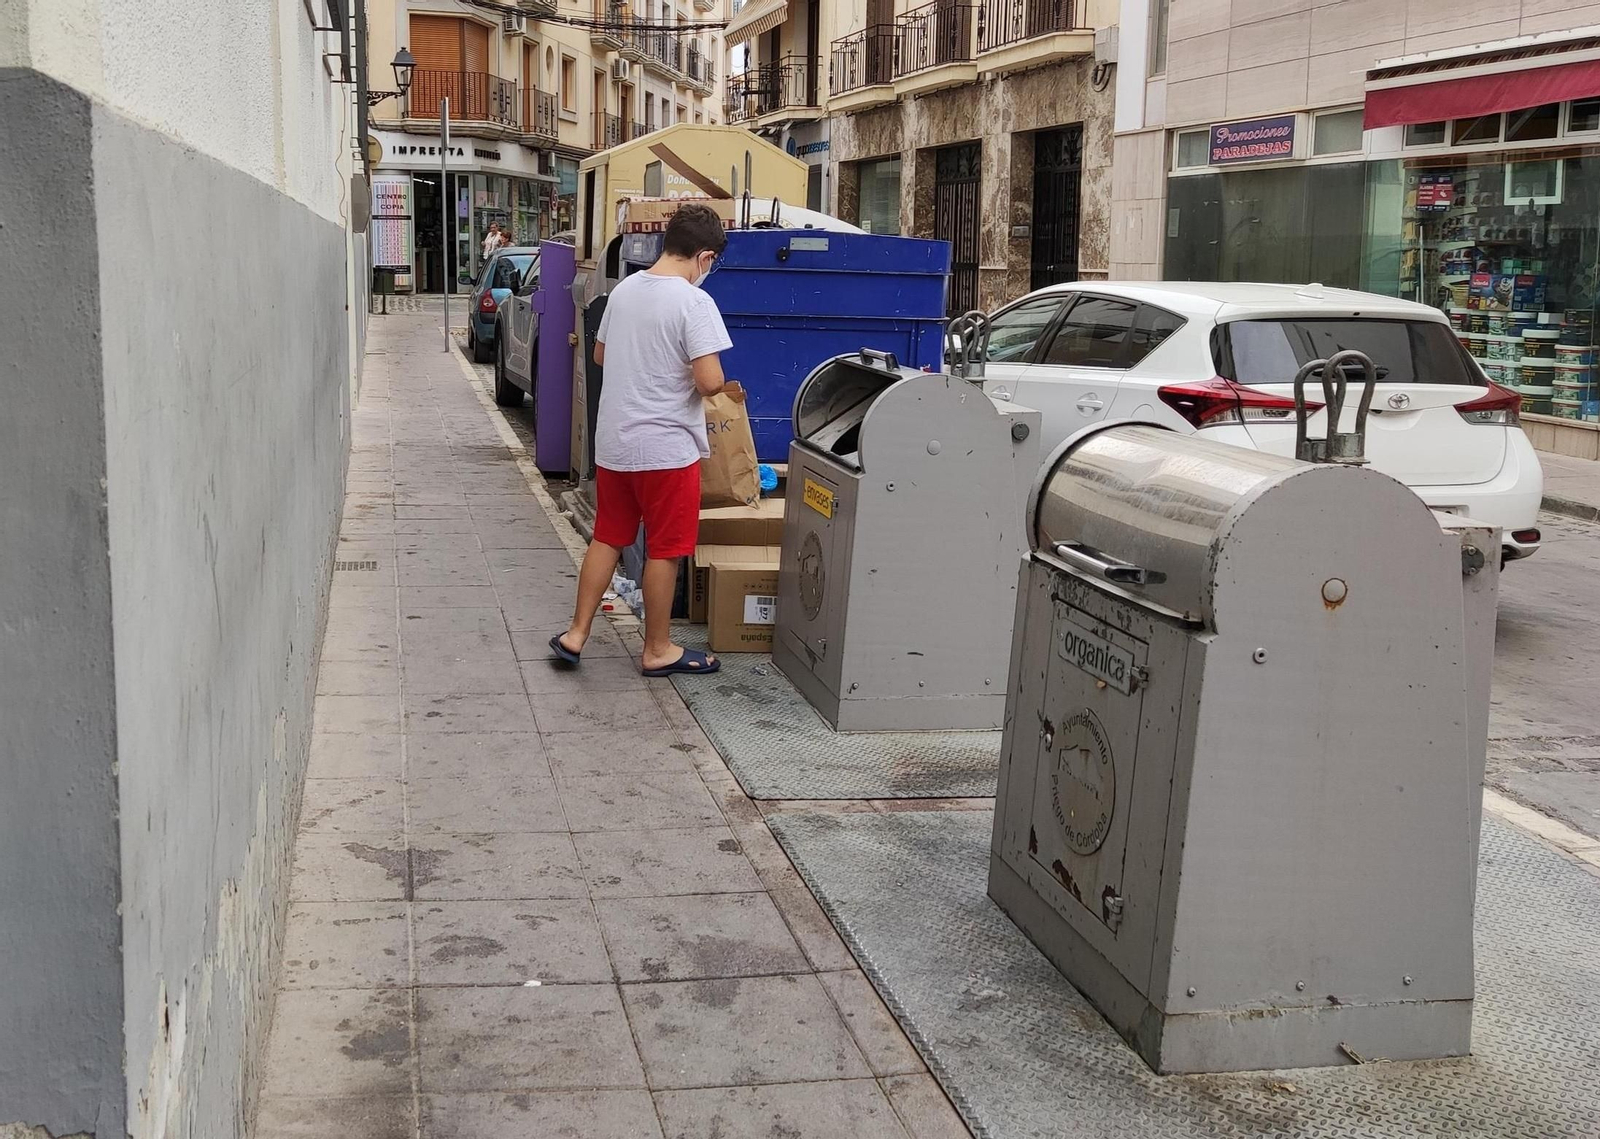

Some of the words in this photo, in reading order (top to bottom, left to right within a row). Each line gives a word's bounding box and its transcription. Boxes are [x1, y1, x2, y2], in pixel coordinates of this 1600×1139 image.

[1212, 141, 1291, 160] PARADEJAS
[1216, 126, 1291, 143] Promociones
[740, 633, 773, 643] España
[1064, 631, 1125, 684] organica
[1061, 711, 1108, 765] Ayuntamiento
[1051, 774, 1065, 825] Priego
[1064, 824, 1075, 842] de
